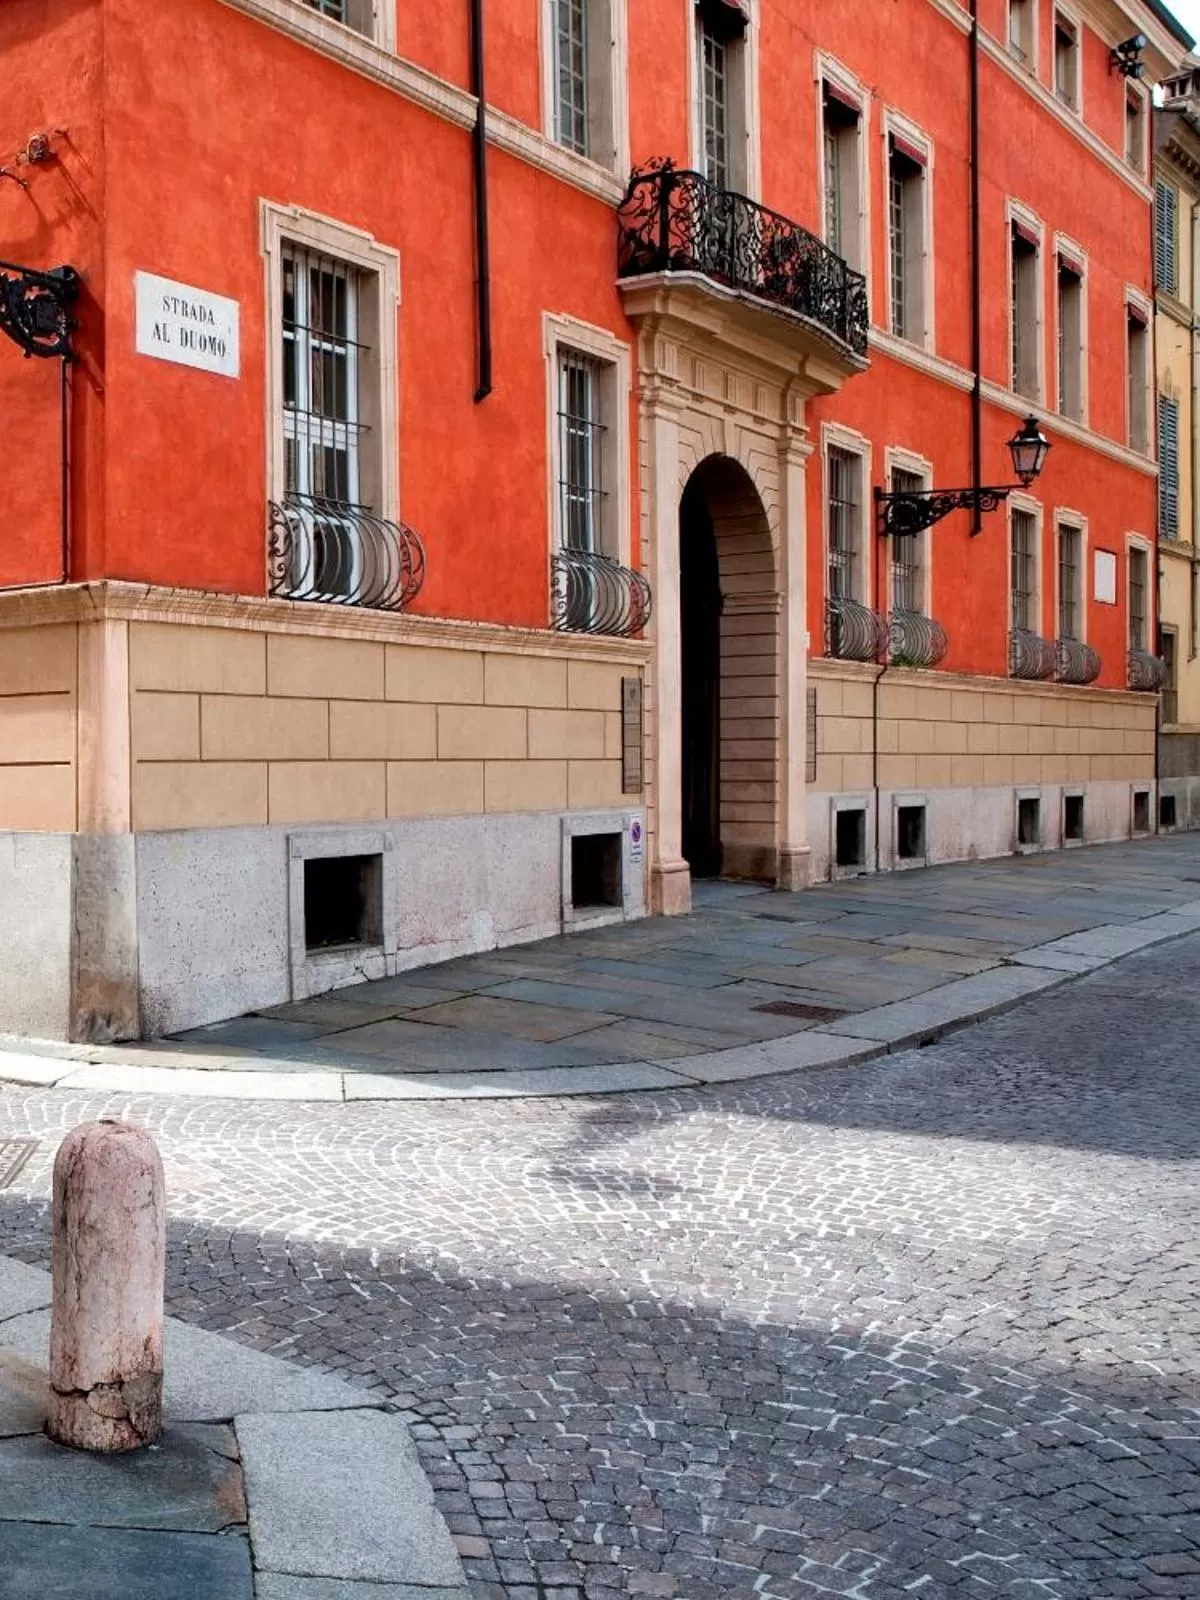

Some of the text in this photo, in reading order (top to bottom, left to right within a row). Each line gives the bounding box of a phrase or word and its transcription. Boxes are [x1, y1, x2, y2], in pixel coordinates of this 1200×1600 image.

[162, 296, 215, 326] STRADA
[152, 322, 226, 358] AL DUOMO
